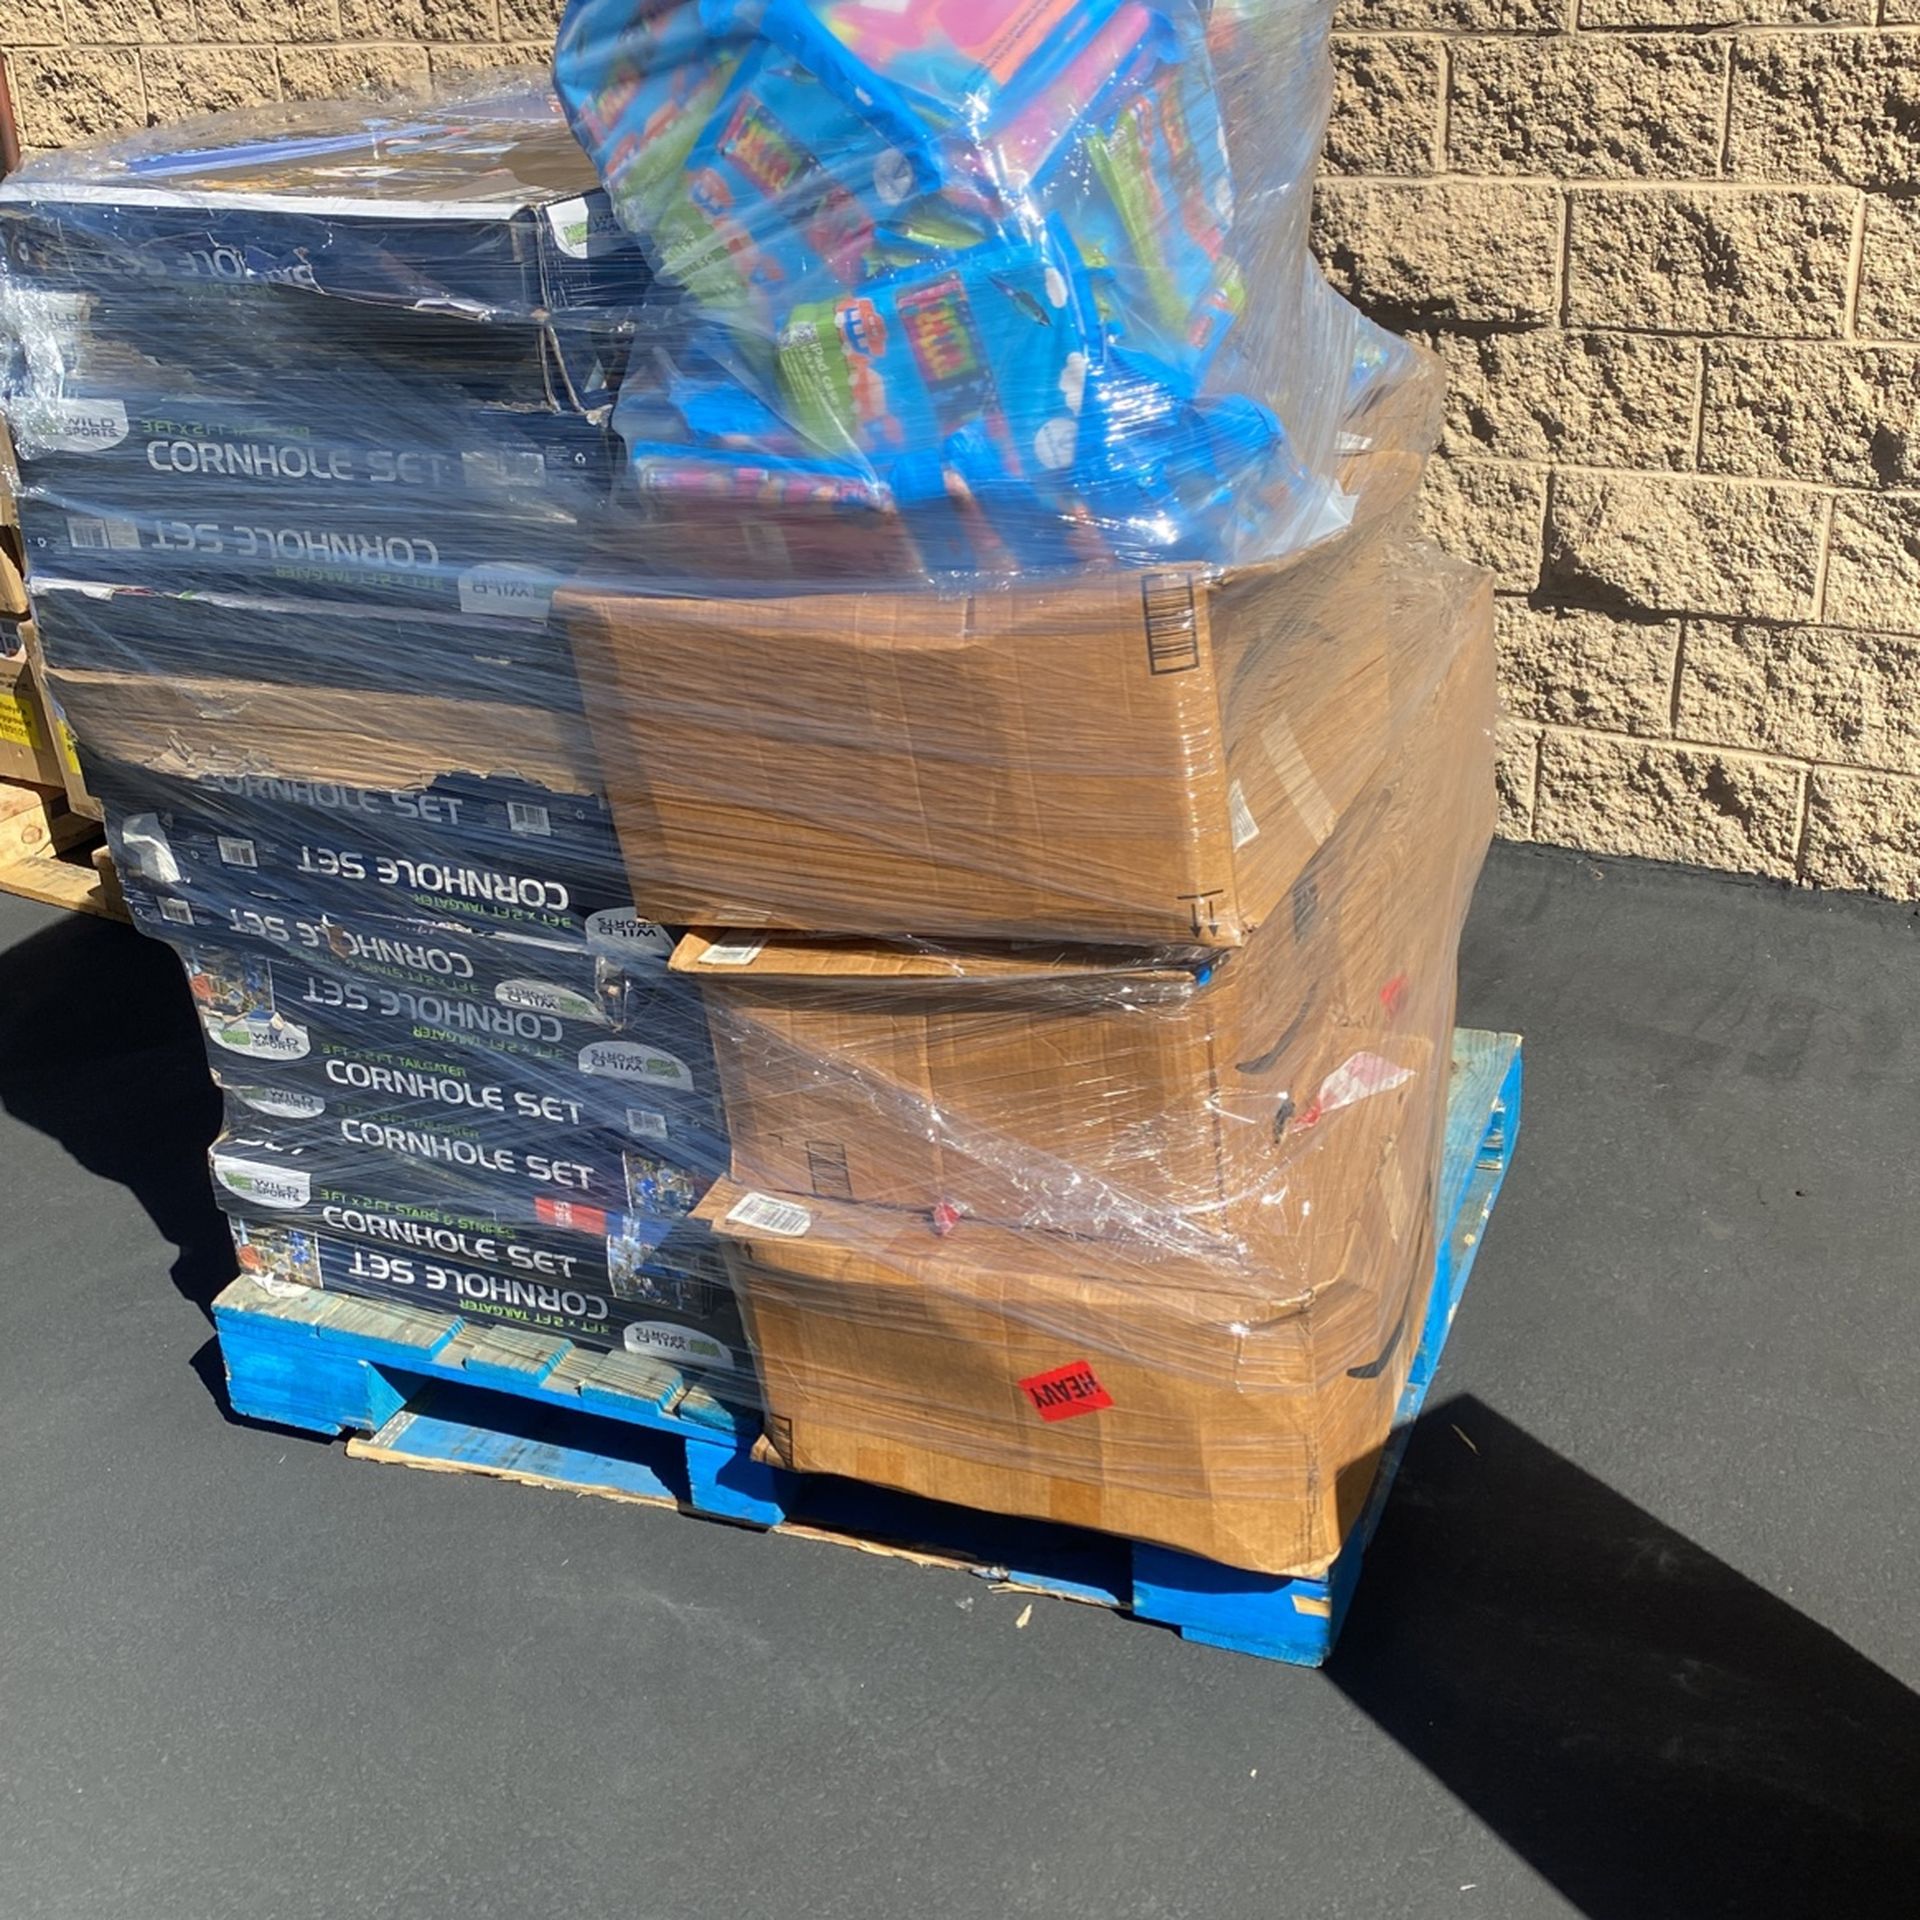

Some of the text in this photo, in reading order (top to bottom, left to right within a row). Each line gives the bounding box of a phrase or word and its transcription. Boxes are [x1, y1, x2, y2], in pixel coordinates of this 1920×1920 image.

[65, 427, 118, 438] SPORTS
[147, 440, 447, 484] CORNHOLE SET
[153, 521, 223, 553] SET
[233, 526, 439, 567] CORNHOLE
[201, 775, 463, 825] ORNHOLE SET
[297, 845, 569, 911] CORNHOLE SET
[229, 909, 290, 942] SET
[599, 927, 657, 938] WILD
[296, 922, 474, 978] CORNHE
[303, 977, 563, 1042] CORNHOLE SET
[325, 1059, 584, 1125] CORNHOLE SET
[340, 1118, 595, 1190] CORNHOLE SET
[254, 1178, 300, 1194] WILD
[395, 1204, 439, 1223] STARS
[322, 1206, 577, 1278] CORNHOLE SET
[349, 1251, 608, 1320] CORNHOLE SET
[460, 1298, 530, 1322] TAILGATER
[635, 1327, 686, 1345] SPORTS
[1030, 1371, 1101, 1408] HEAVY
